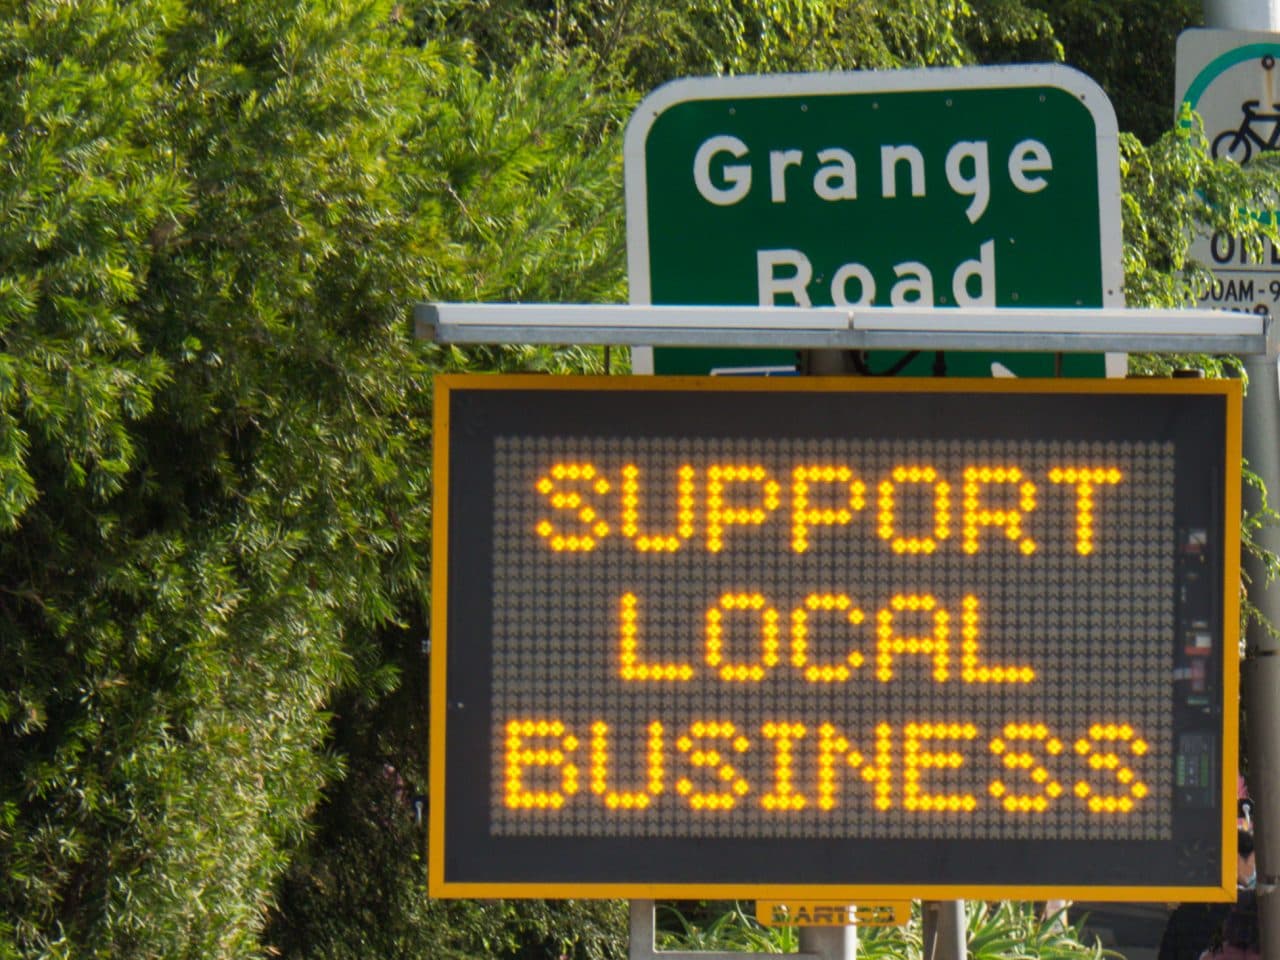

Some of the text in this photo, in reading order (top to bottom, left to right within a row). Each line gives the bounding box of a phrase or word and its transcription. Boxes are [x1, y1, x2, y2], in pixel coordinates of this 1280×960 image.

[693, 134, 1054, 224] Grange
[757, 238, 997, 308] Road
[535, 462, 1124, 555] SUPPORT
[618, 591, 1037, 684] LOCAL
[503, 720, 1150, 814] BUSINESS
